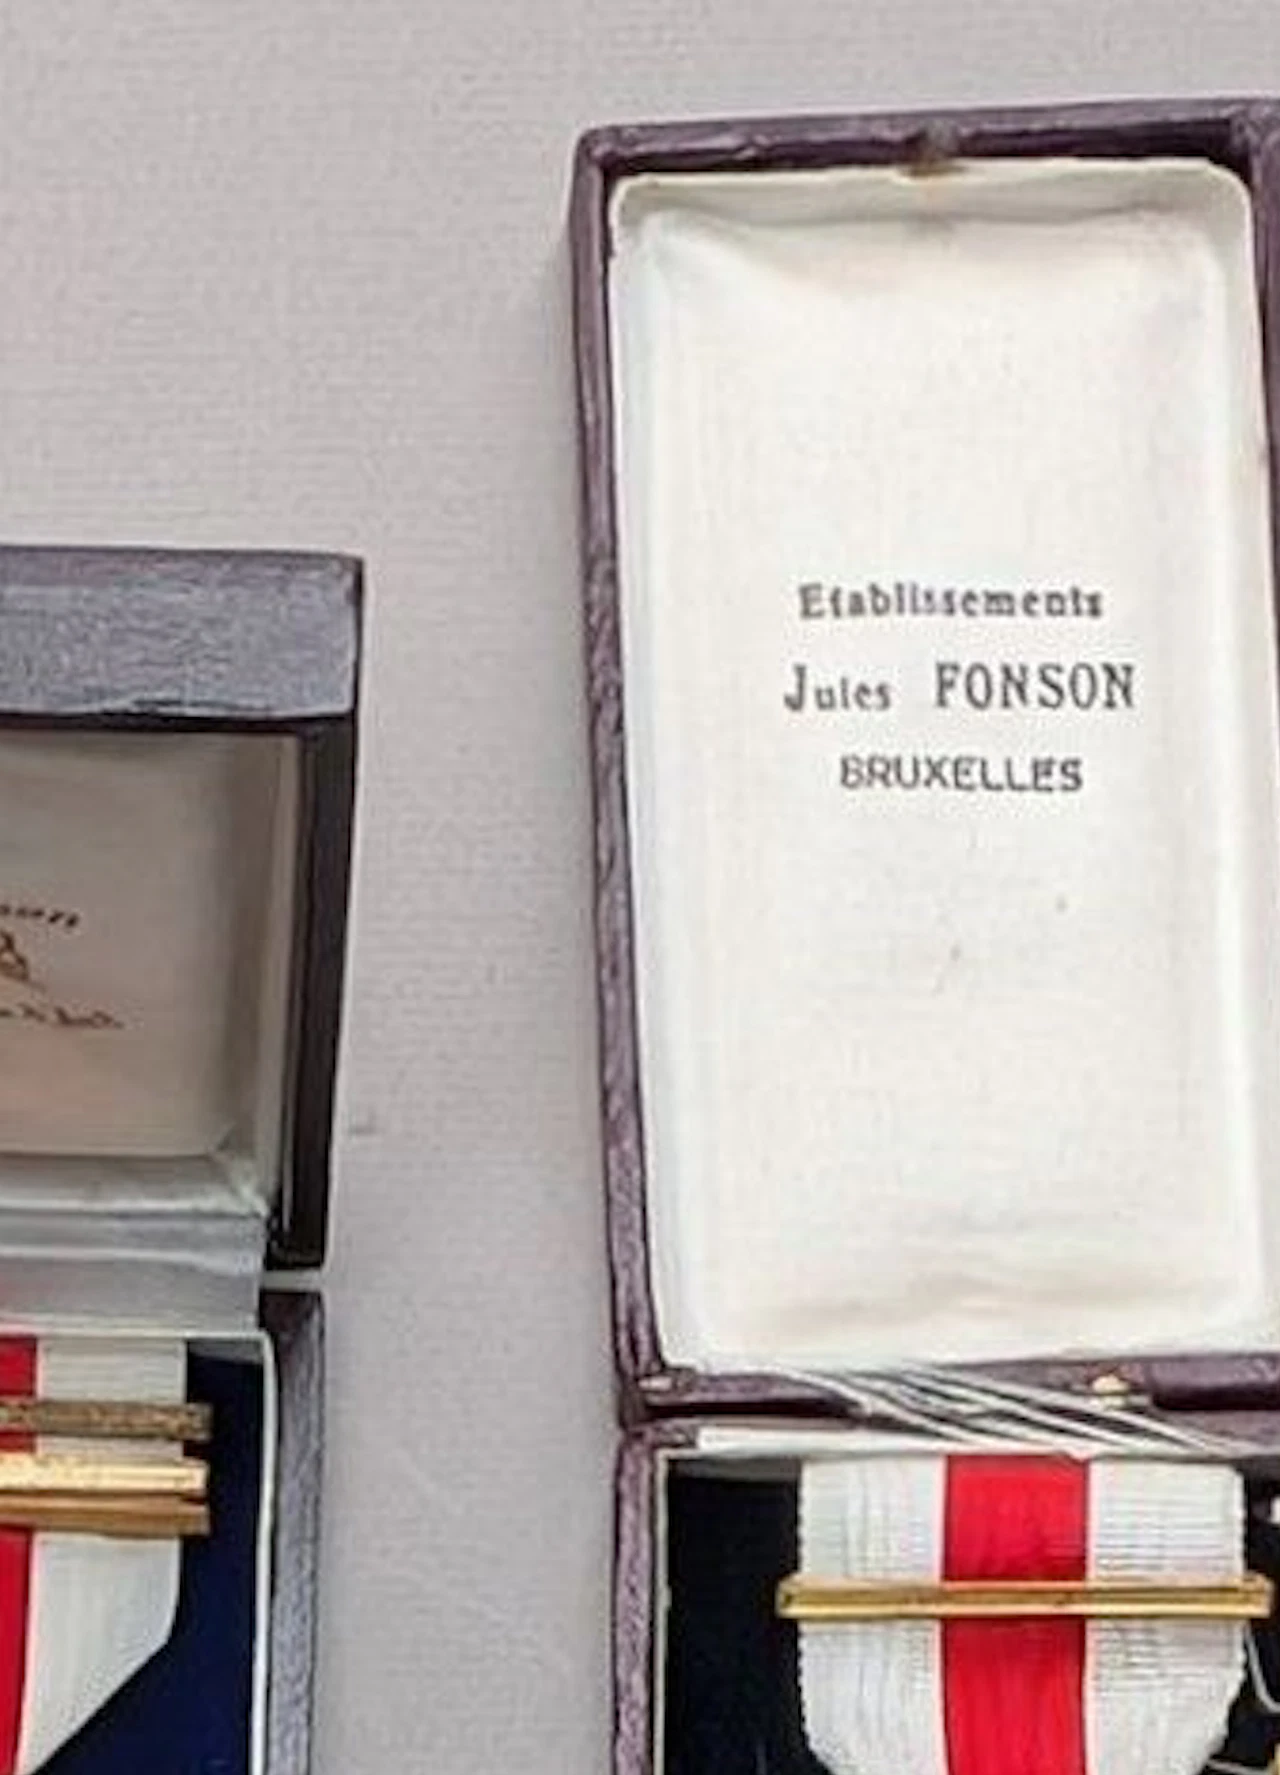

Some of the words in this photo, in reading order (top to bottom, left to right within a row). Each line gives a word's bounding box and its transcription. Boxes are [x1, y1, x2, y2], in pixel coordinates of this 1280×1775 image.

[799, 582, 1103, 619] Etablissements
[784, 663, 893, 712] Jules
[934, 661, 1135, 711] FONSON
[839, 755, 1084, 793] BRUXELLES
